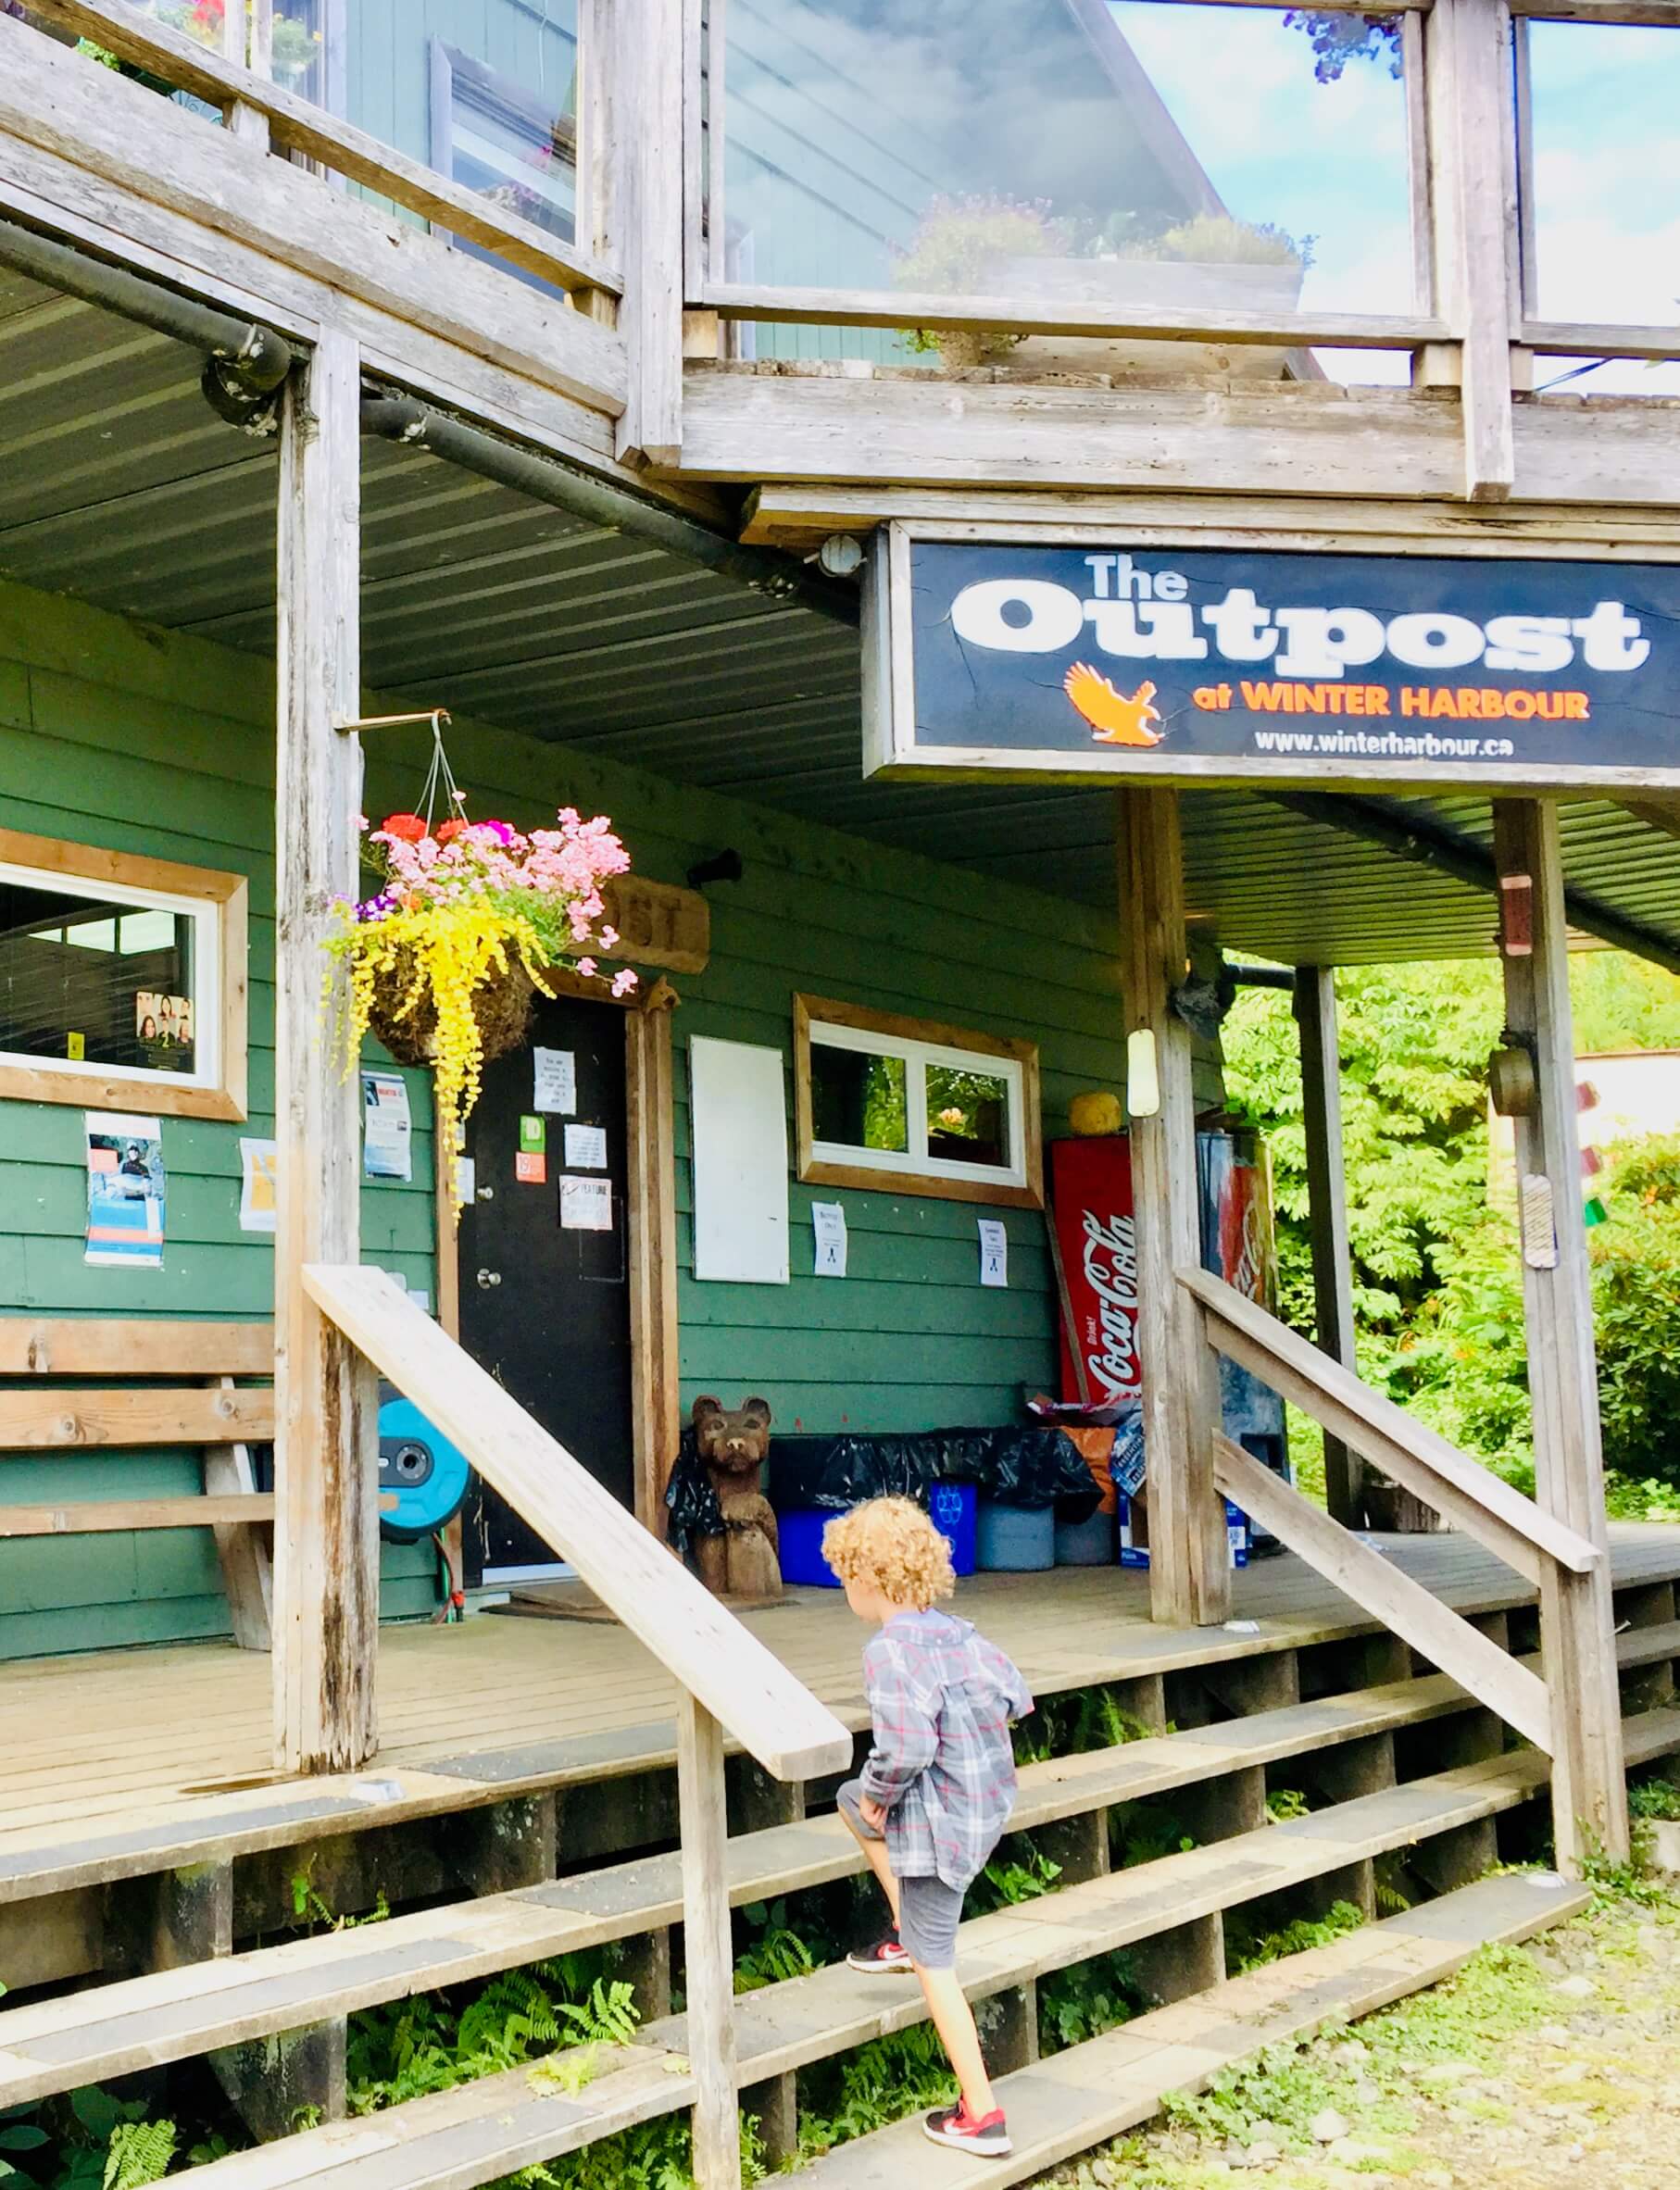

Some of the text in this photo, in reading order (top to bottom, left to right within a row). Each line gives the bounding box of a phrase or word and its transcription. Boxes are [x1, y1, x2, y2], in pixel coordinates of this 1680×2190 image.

[1084, 554, 1188, 601] The
[950, 579, 1651, 679] Outpost
[1192, 681, 1592, 720] at WINTER HARBOUR
[1255, 730, 1514, 757] www.winterharbour.ca
